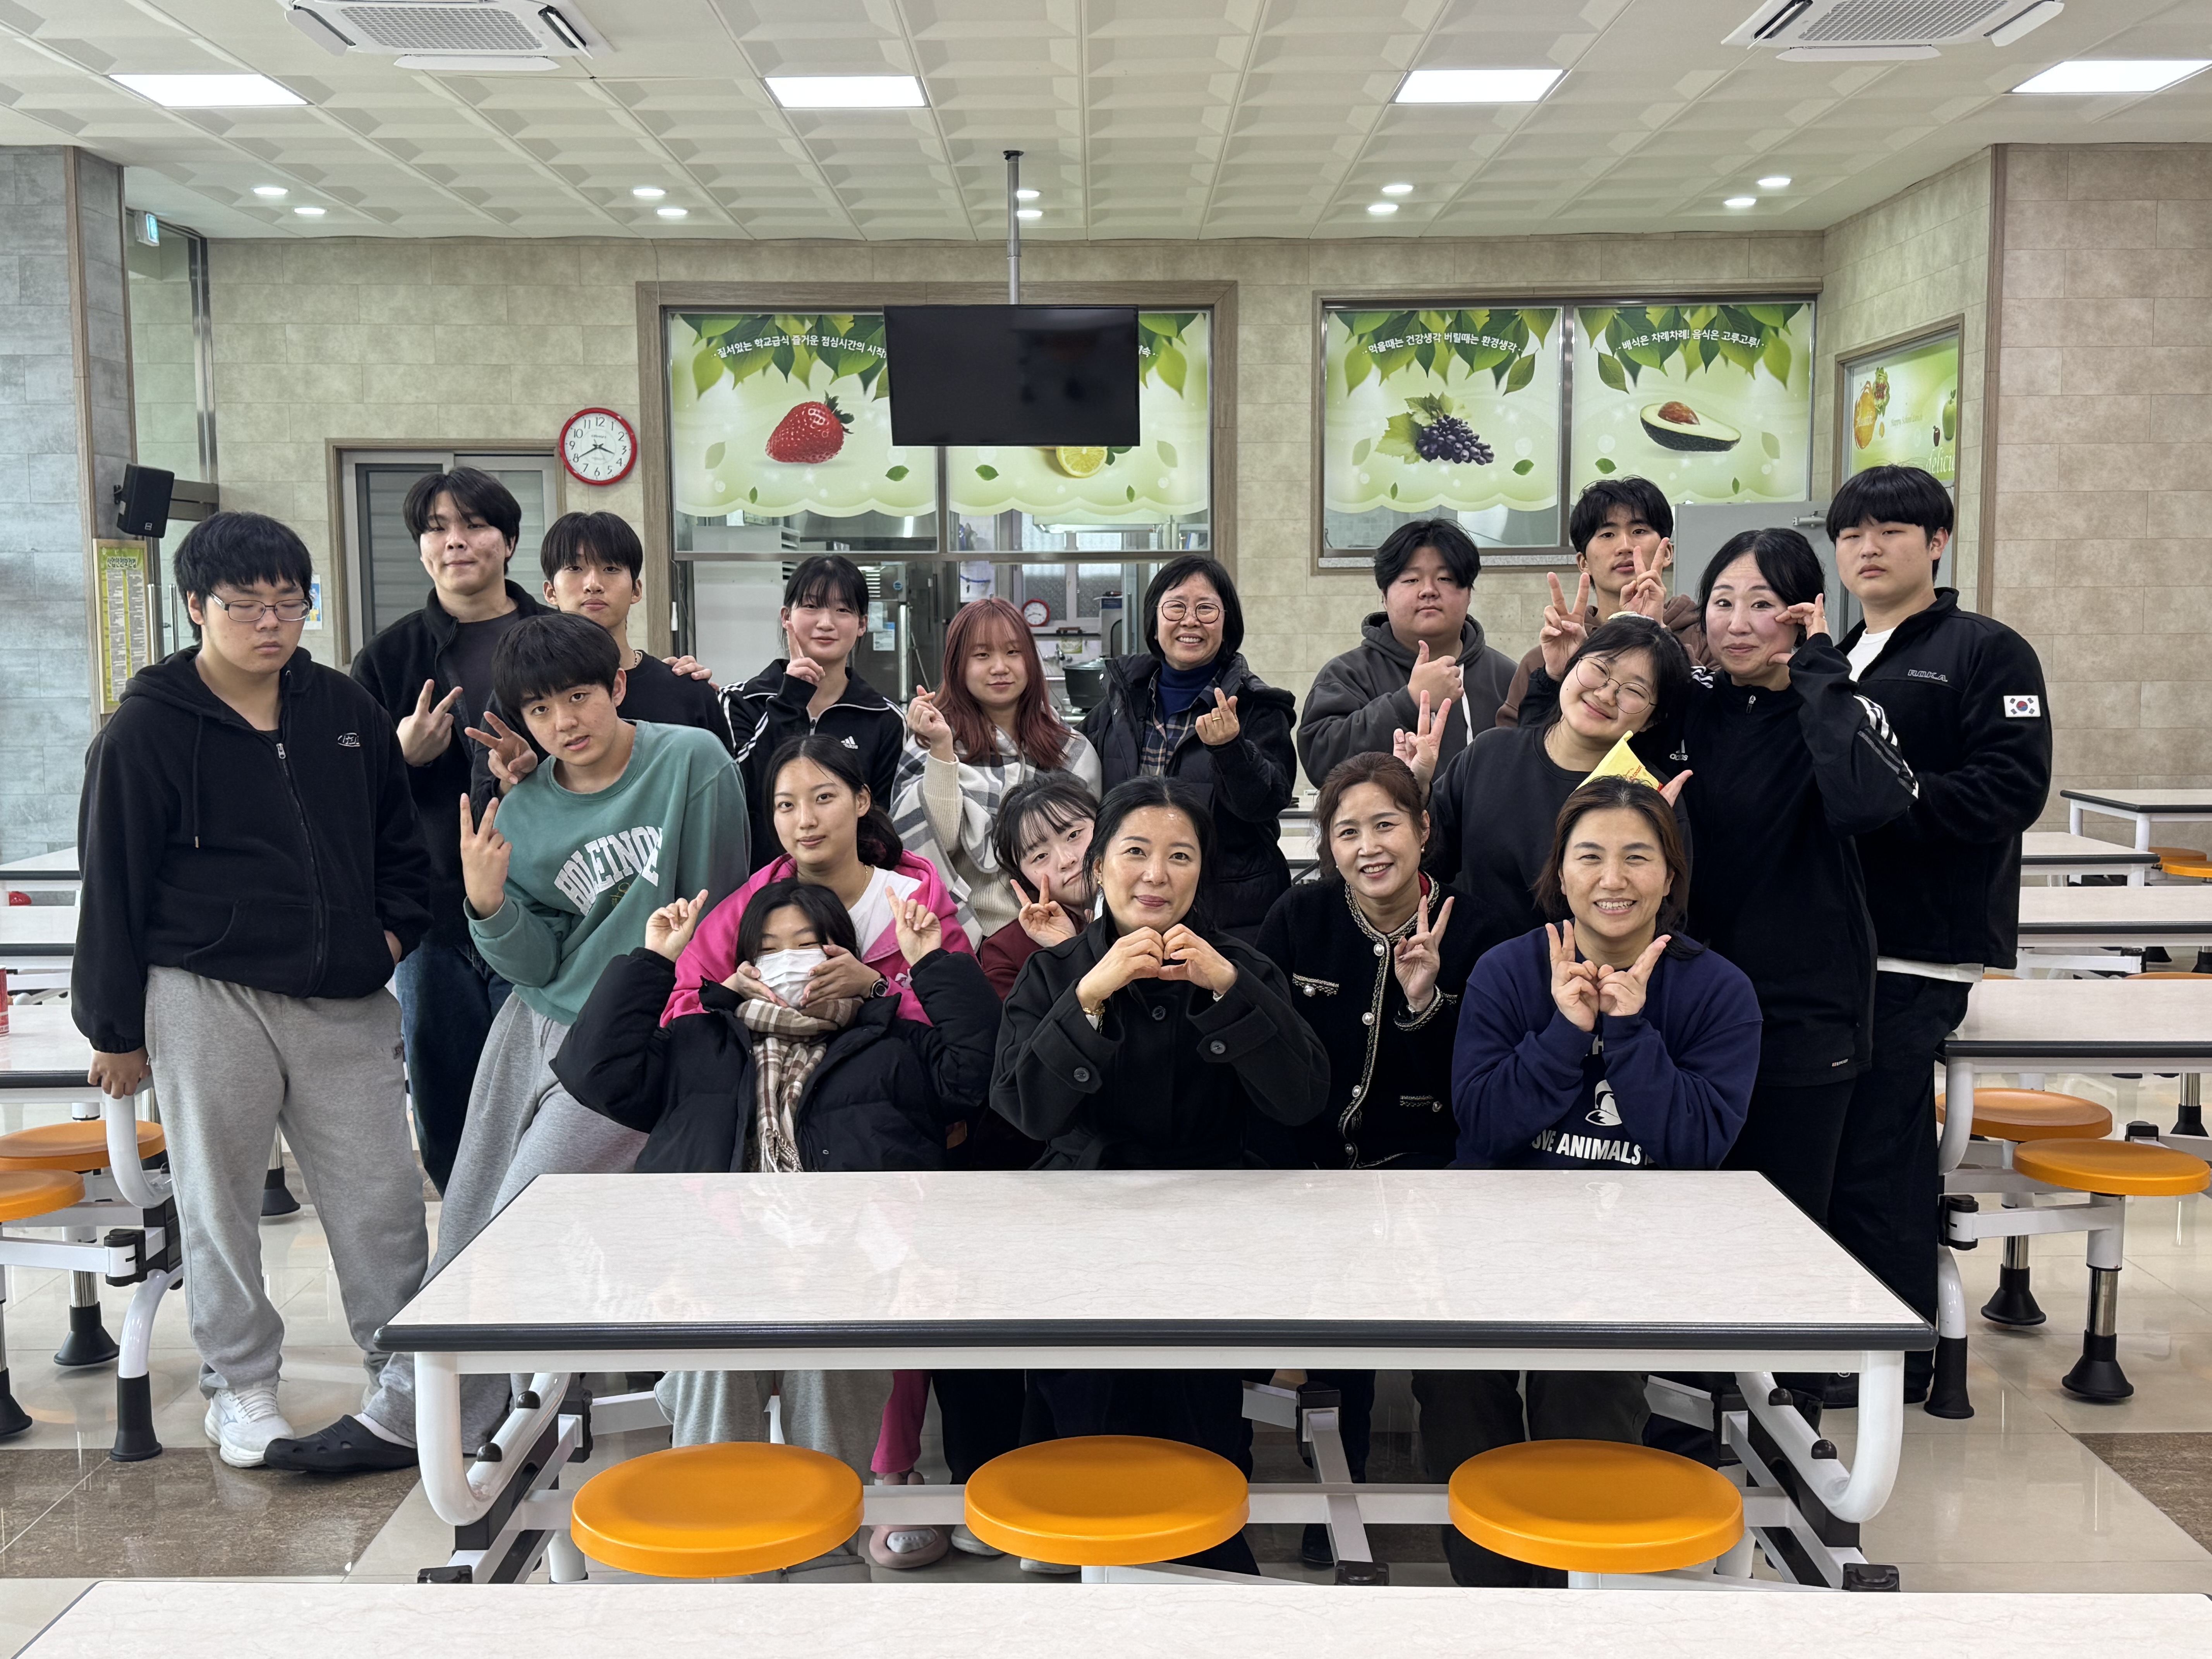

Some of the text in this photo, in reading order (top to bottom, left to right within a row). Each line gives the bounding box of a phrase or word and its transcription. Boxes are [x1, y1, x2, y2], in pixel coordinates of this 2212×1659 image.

[1368, 333, 1518, 354] 먹을때는 건강생각 버릴때는 환경생각
[1622, 329, 1760, 350] 배식은 차례차례! 음식은 고루고루!
[717, 342, 752, 358] 질서있는
[754, 336, 789, 349] 학교급식
[792, 335, 819, 345] 즐거운
[821, 336, 866, 353] 점심시간의
[584, 419, 591, 429] 11
[596, 417, 605, 427] 12
[574, 429, 583, 438] 10
[618, 431, 625, 441] 2
[569, 441, 575, 450] 9
[622, 446, 627, 455] 3
[573, 453, 579, 463] 8
[616, 458, 622, 467] 4
[582, 464, 589, 472] 7
[594, 467, 600, 477] 6
[607, 465, 613, 475] 5
[1556, 1133, 1642, 1165] ANIMALS
